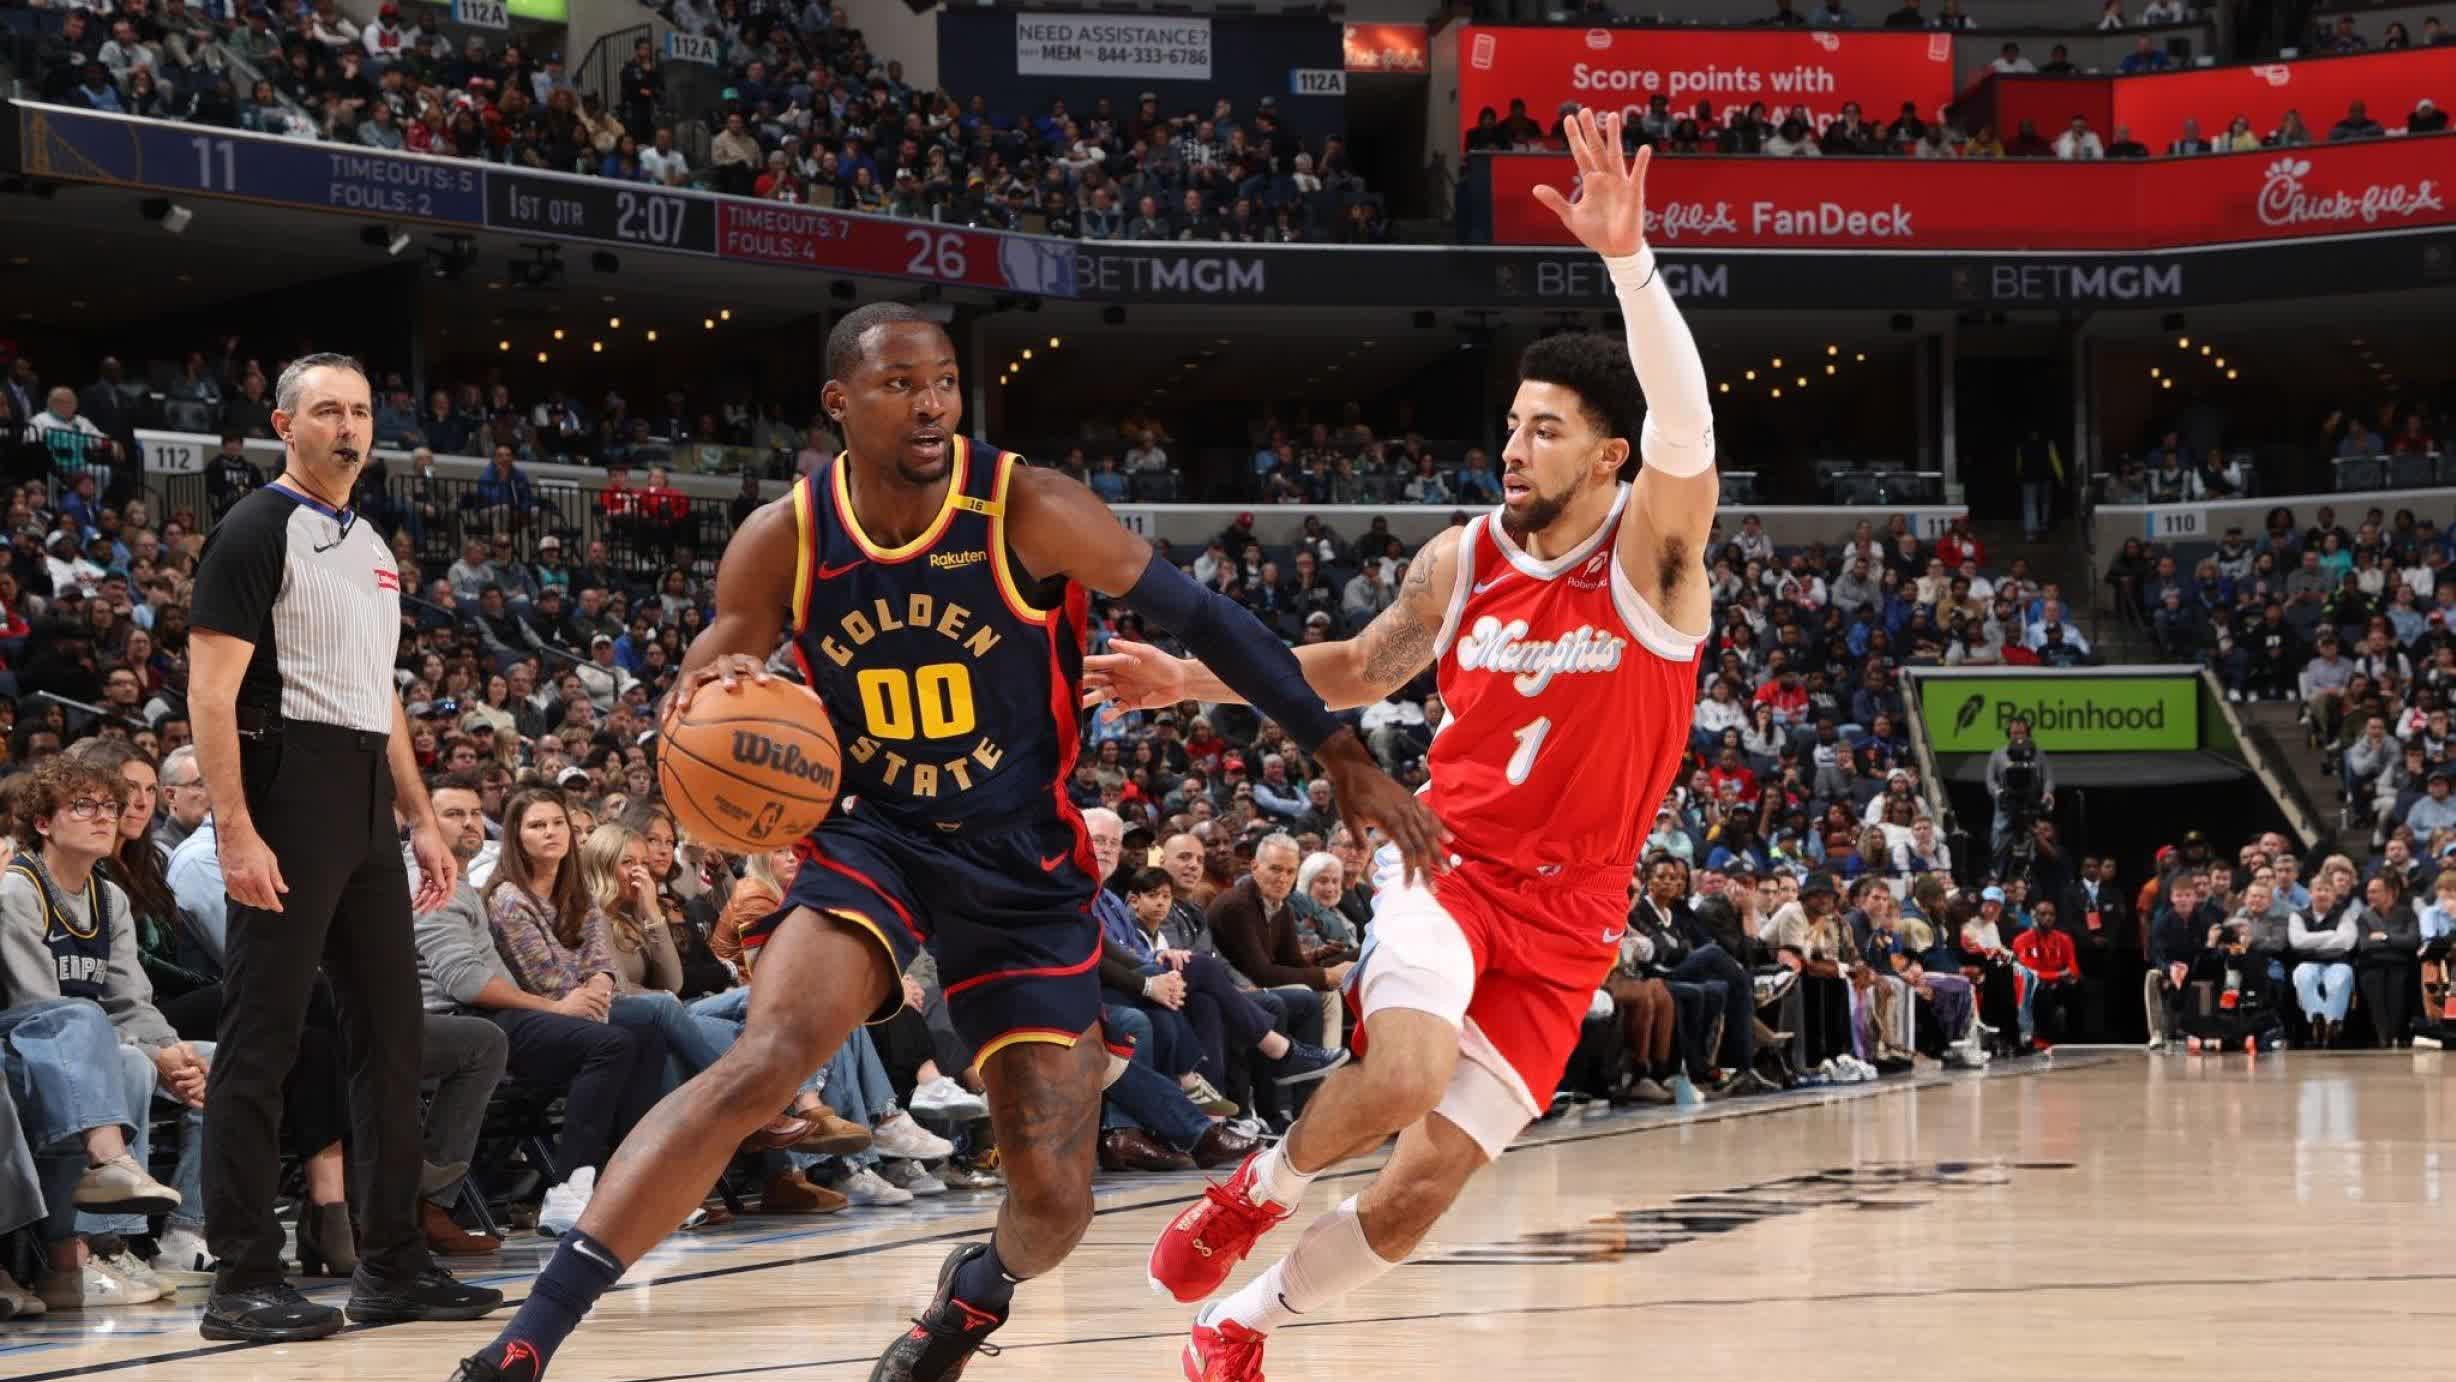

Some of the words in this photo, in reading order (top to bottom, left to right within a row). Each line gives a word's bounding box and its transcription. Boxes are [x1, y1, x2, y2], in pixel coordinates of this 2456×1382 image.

[674, 35, 713, 58] 112A
[1019, 24, 1073, 41] NEED
[1079, 27, 1208, 46] ASSISTANCE?
[1042, 45, 1081, 61] MEM
[1097, 47, 1208, 64] 844-333-6786
[1301, 72, 1341, 91] 112A
[1573, 63, 1660, 90] Score
[1669, 64, 1761, 97] points
[1771, 65, 1834, 92] with
[192, 137, 236, 192] 11
[330, 154, 454, 189] TIMEOUTS:
[459, 171, 473, 192] 5
[330, 183, 413, 212] FOULS:
[417, 193, 433, 215] 2
[617, 191, 686, 245] 2:07
[728, 207, 833, 238] TIMEOUTS:
[838, 220, 850, 240] 7
[1752, 202, 1913, 236] FanDeck
[728, 231, 797, 257] FOULS:
[803, 242, 816, 259] 4
[905, 228, 967, 279] 26
[1077, 255, 1265, 293] BETMGM
[1536, 261, 1729, 298] BETGM
[1991, 263, 2183, 299] BETMGM
[156, 447, 191, 470] 112
[969, 499, 984, 511] 16
[2165, 513, 2196, 533] 110
[929, 550, 987, 569] Rakuten
[820, 593, 1002, 667] GOLDEN
[1456, 615, 1628, 697] Memphis
[856, 662, 976, 740] 00
[1996, 699, 2165, 730] Robinhood
[732, 729, 834, 791] Wilson
[849, 735, 1004, 798] STATE
[1505, 715, 1552, 786] 1
